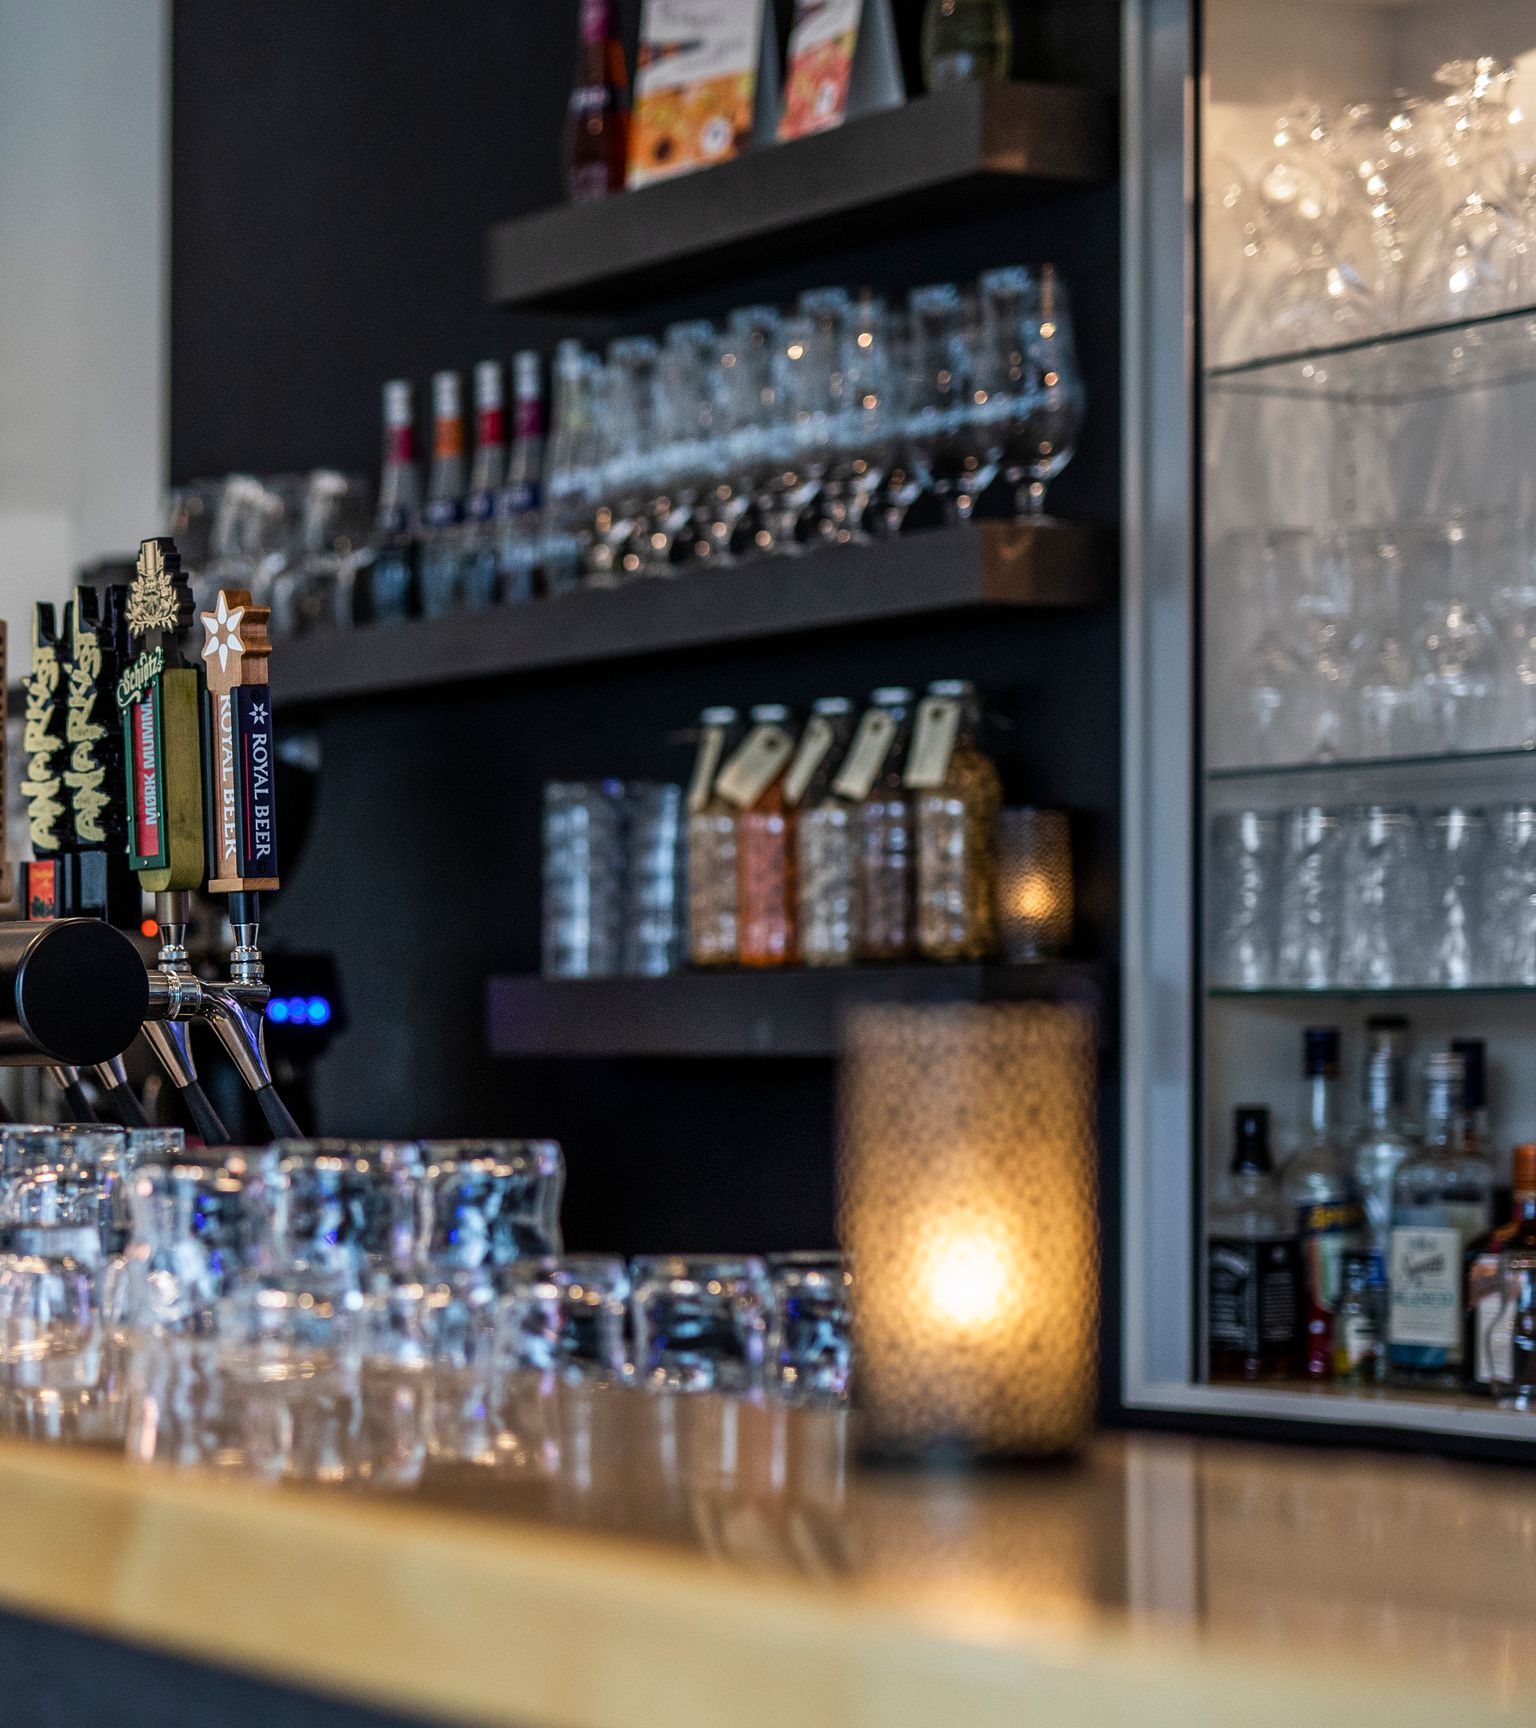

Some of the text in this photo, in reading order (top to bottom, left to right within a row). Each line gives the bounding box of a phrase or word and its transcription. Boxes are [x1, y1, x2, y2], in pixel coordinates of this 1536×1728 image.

[143, 772, 158, 827] MØRK
[252, 732, 271, 861] ROYAL BEER
